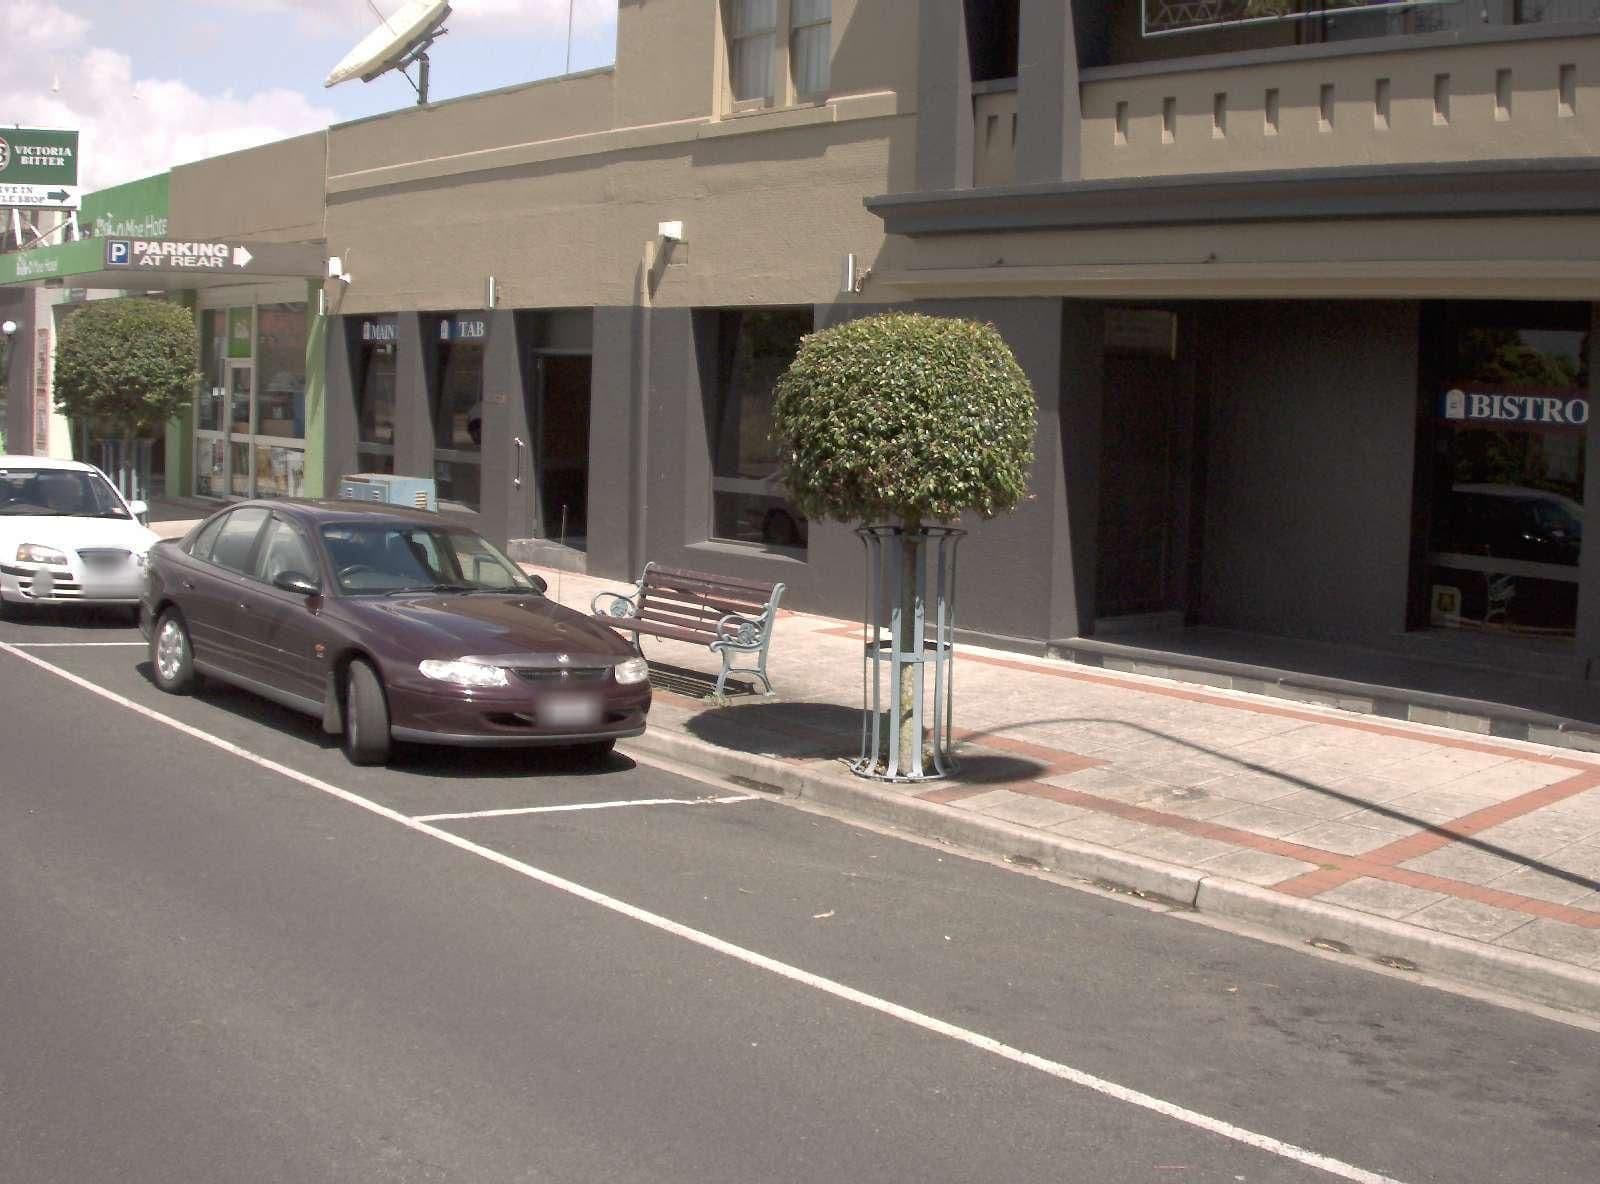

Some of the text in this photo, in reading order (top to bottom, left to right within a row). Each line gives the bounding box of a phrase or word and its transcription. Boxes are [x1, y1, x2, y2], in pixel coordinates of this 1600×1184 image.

[14, 146, 72, 157] VICTORIA
[20, 156, 65, 166] BITTER
[111, 243, 126, 262] P
[133, 241, 229, 257] PARKING
[139, 255, 225, 268] AT REAR
[369, 324, 396, 340] MAIN
[458, 320, 484, 337] TAB
[1469, 393, 1590, 424] BISTRO
